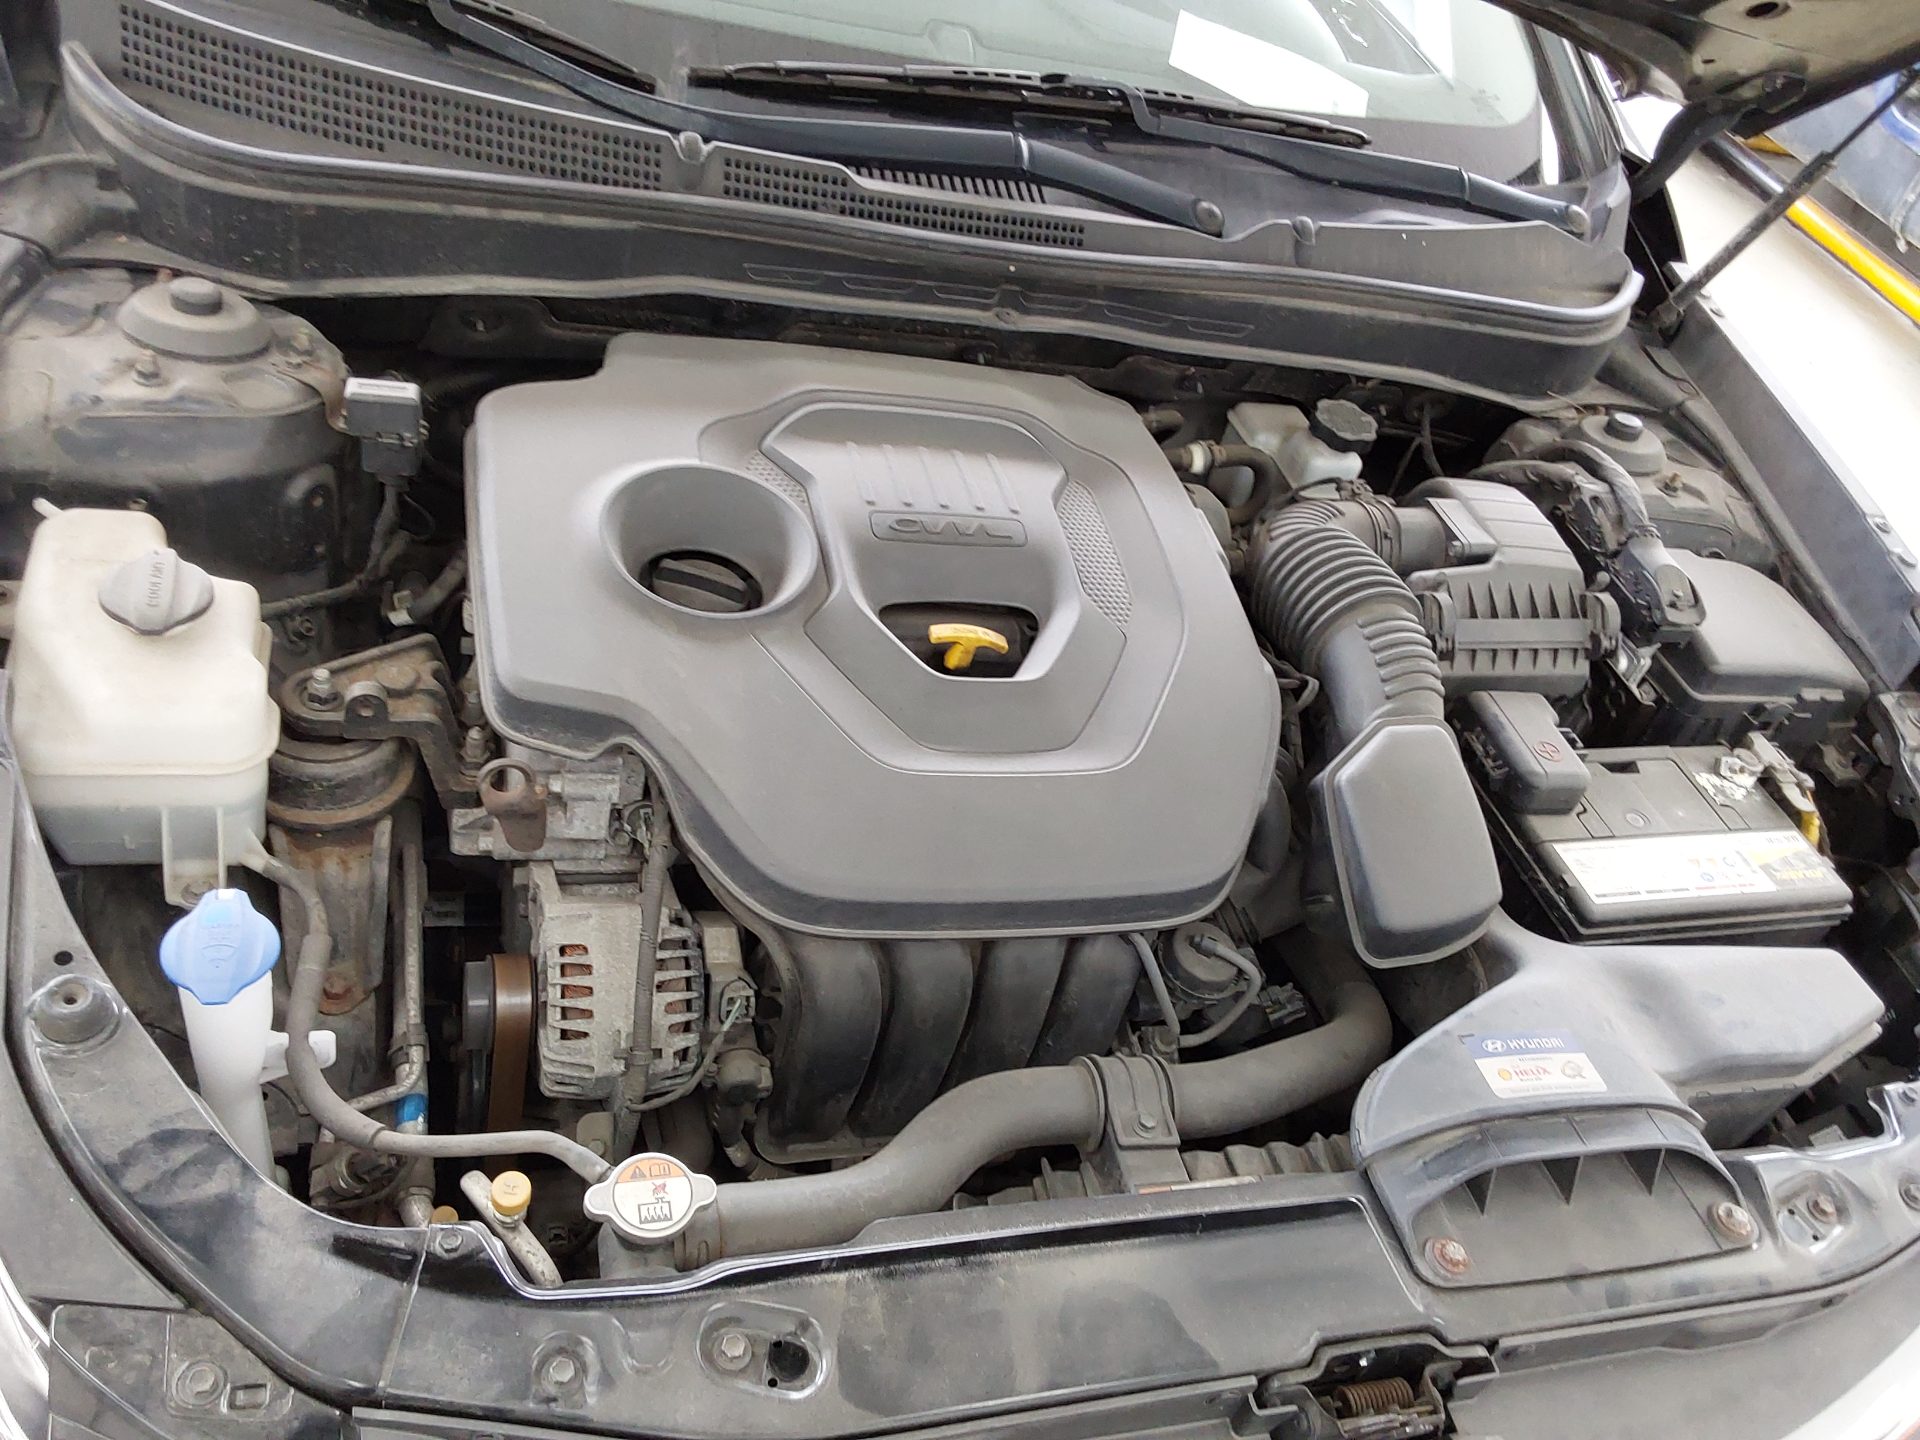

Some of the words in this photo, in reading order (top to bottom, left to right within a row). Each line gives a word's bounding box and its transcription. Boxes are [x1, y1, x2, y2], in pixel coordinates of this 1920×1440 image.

[888, 518, 1014, 541] CVVL
[1506, 1038, 1565, 1050] HYUNDAI
[1513, 1066, 1551, 1078] HELIX
